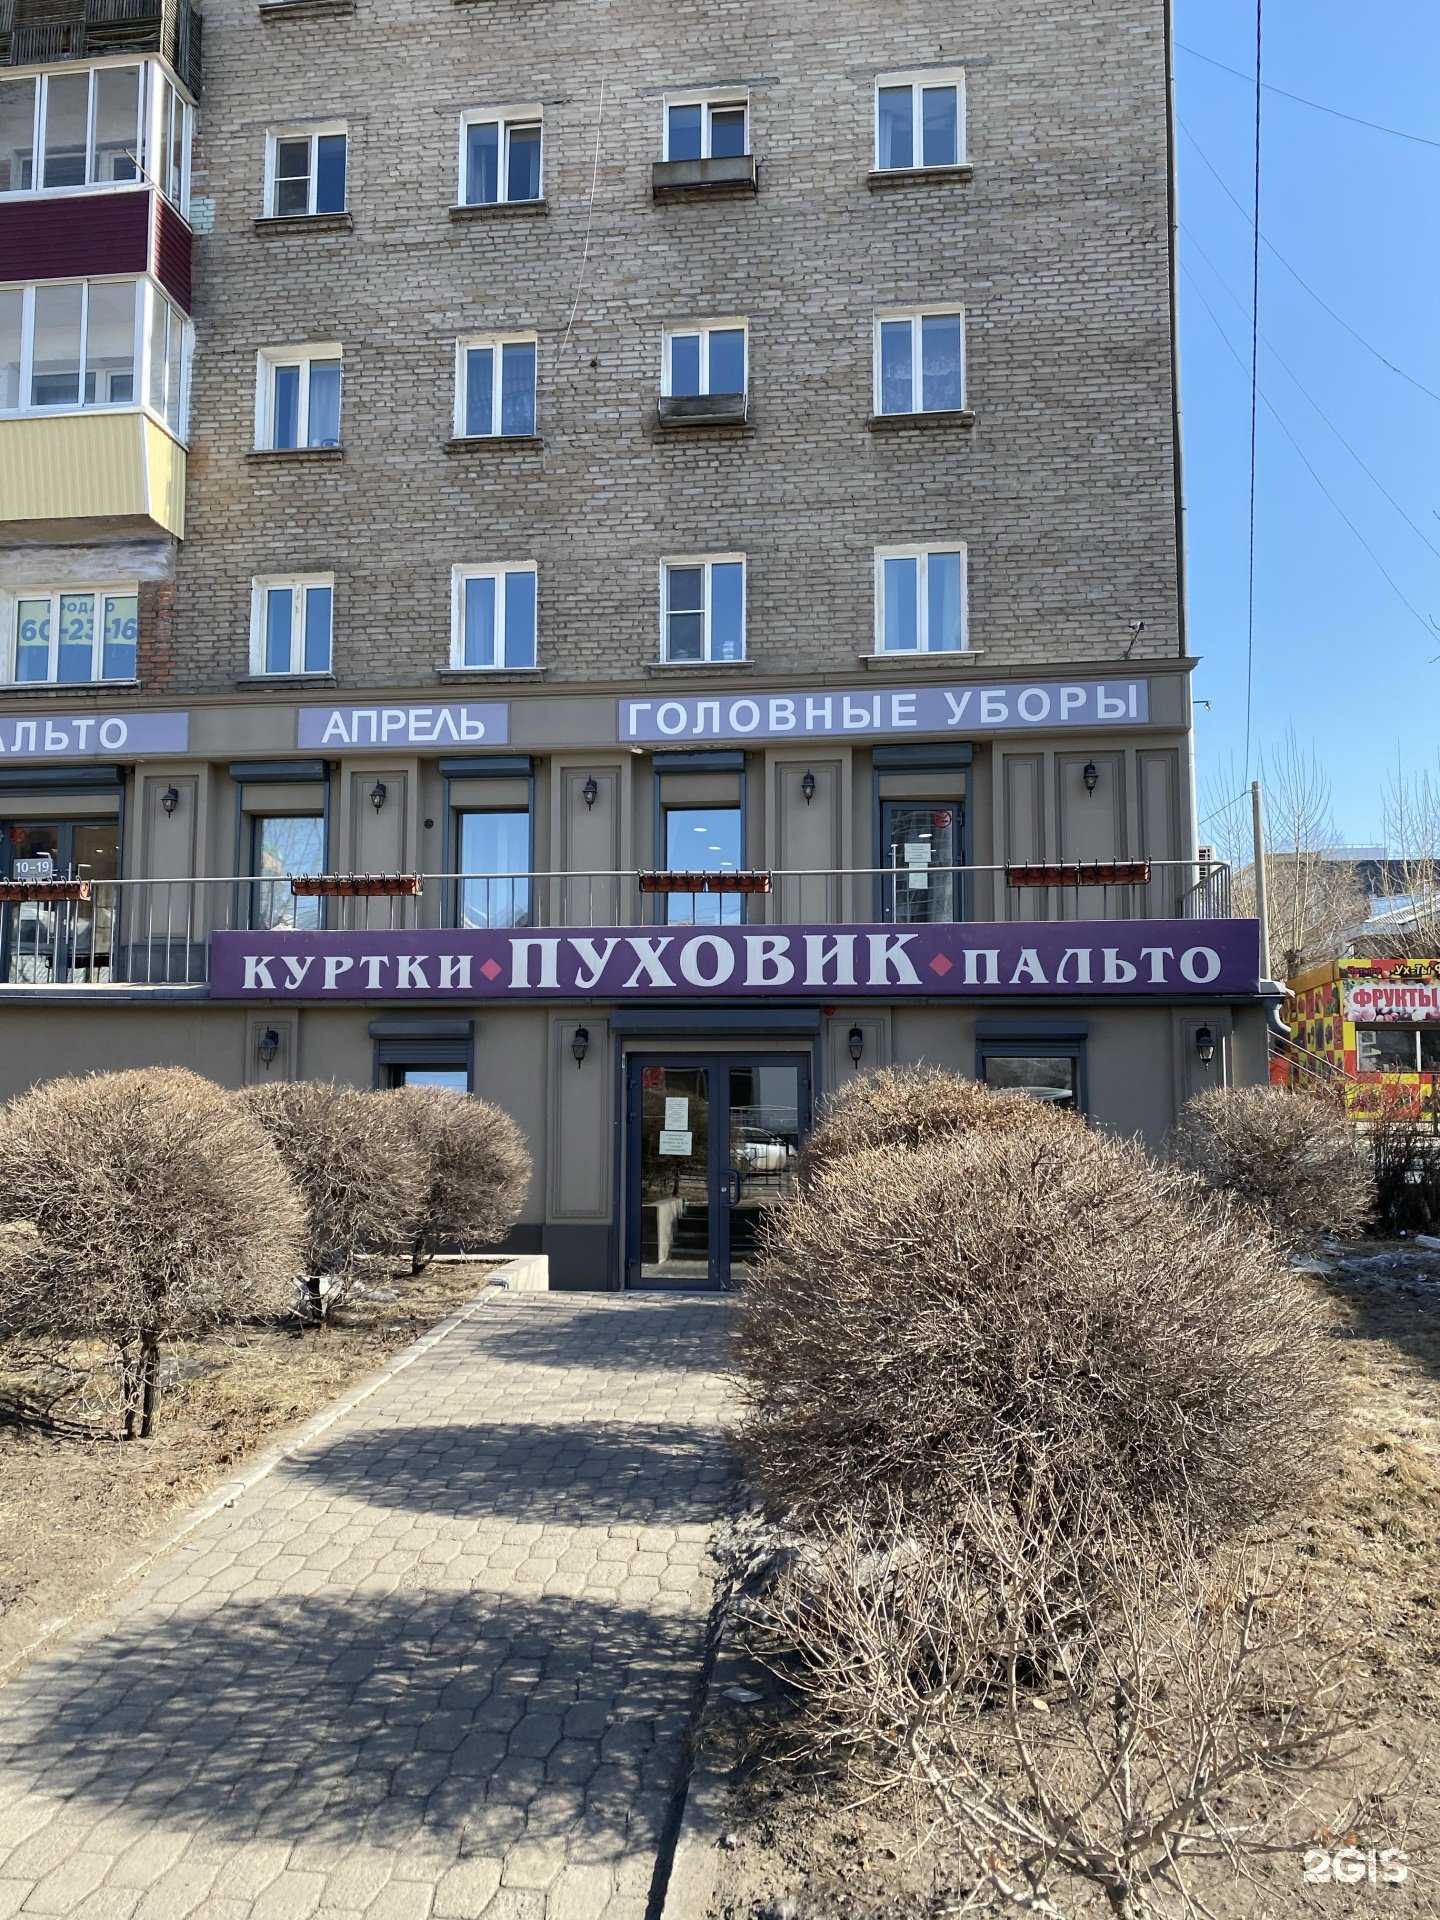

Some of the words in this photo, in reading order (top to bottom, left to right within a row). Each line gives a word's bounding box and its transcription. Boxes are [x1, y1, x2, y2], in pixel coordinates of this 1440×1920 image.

[321, 708, 486, 744] АПРЕЛЬ
[629, 693, 917, 736] ГОЛОВНЫЕ
[944, 684, 1138, 726] УБОРЫ
[0, 717, 128, 752] ЛЬТО
[241, 955, 474, 990] КУРТКИ
[508, 933, 923, 989] ПУХОВИК
[962, 946, 1223, 984] ПАЛЬТО
[1353, 988, 1438, 1008] ФРУКТЫ
